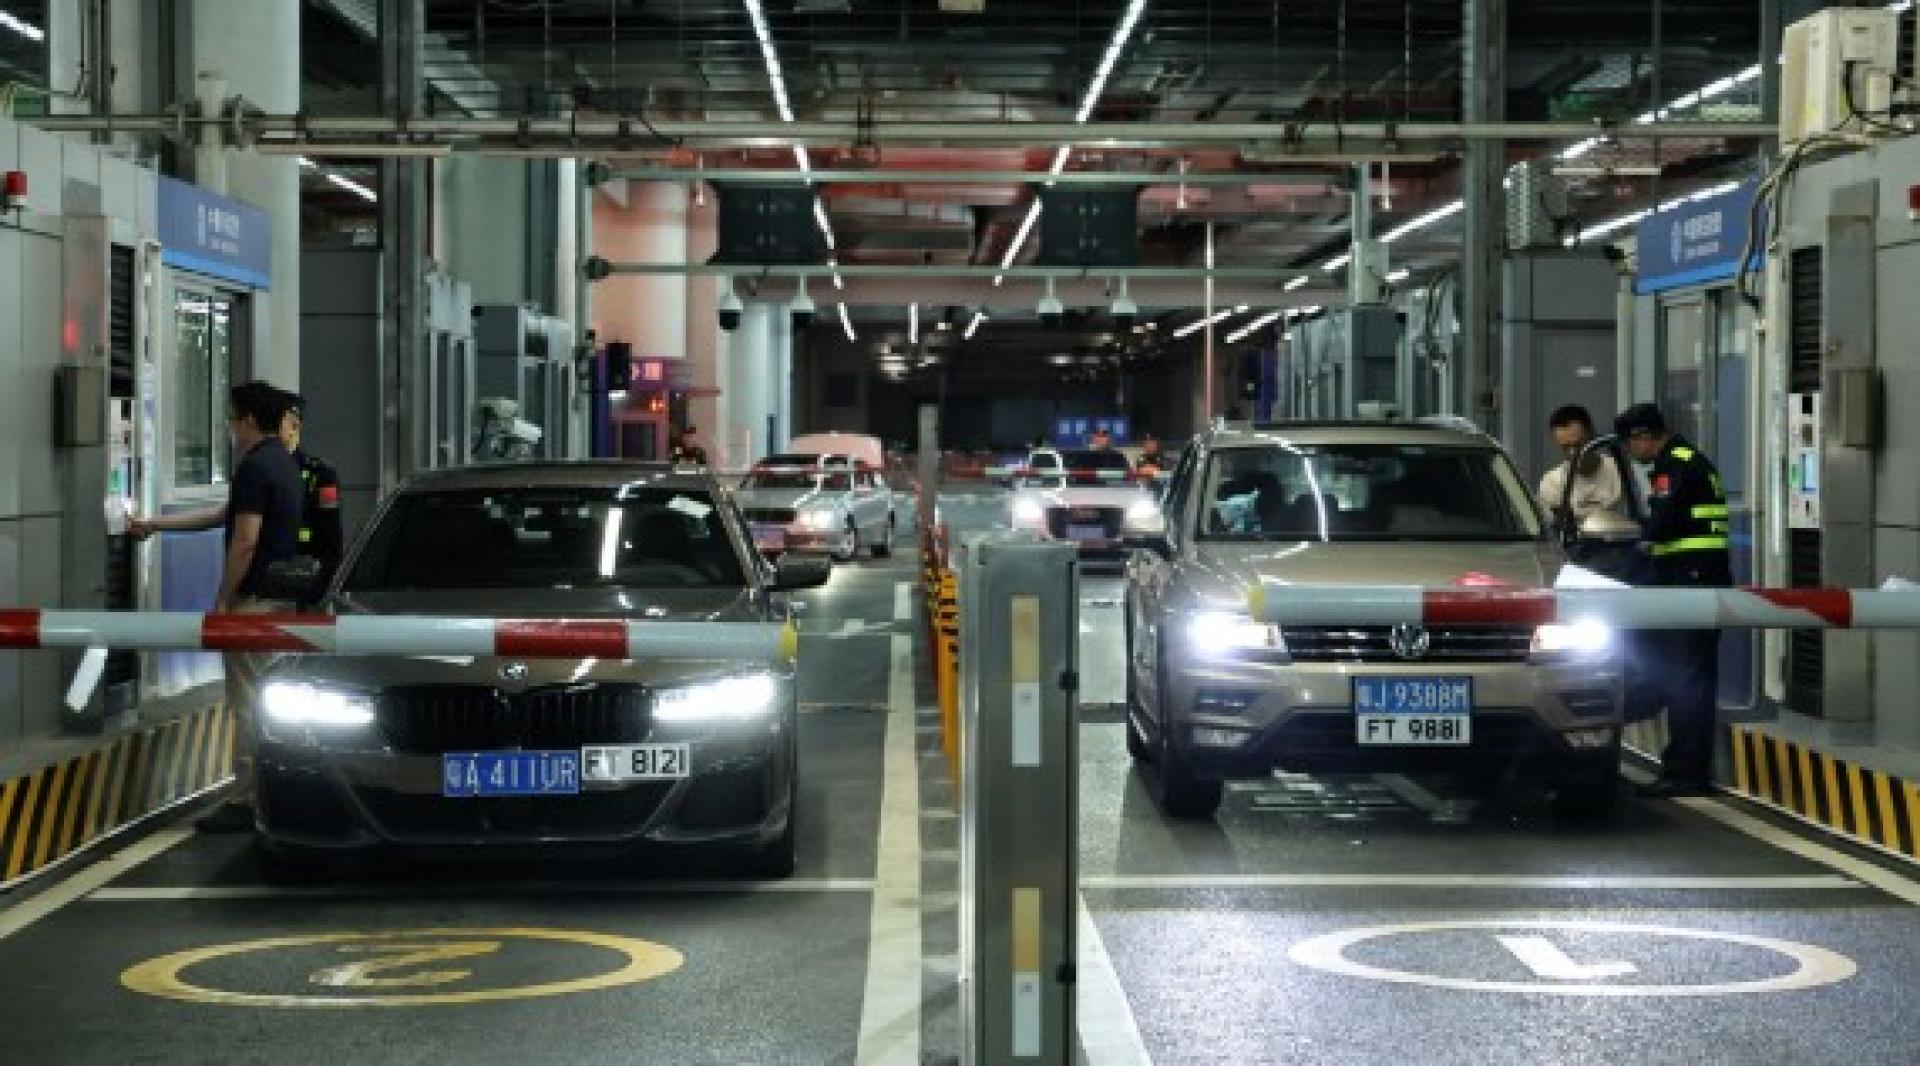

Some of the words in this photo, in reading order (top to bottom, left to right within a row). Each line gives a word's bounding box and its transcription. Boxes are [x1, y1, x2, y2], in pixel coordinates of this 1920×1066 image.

[1368, 719, 1396, 740] FT
[1408, 719, 1460, 740] 9881
[584, 749, 620, 776] FT
[631, 749, 687, 774] 8121
